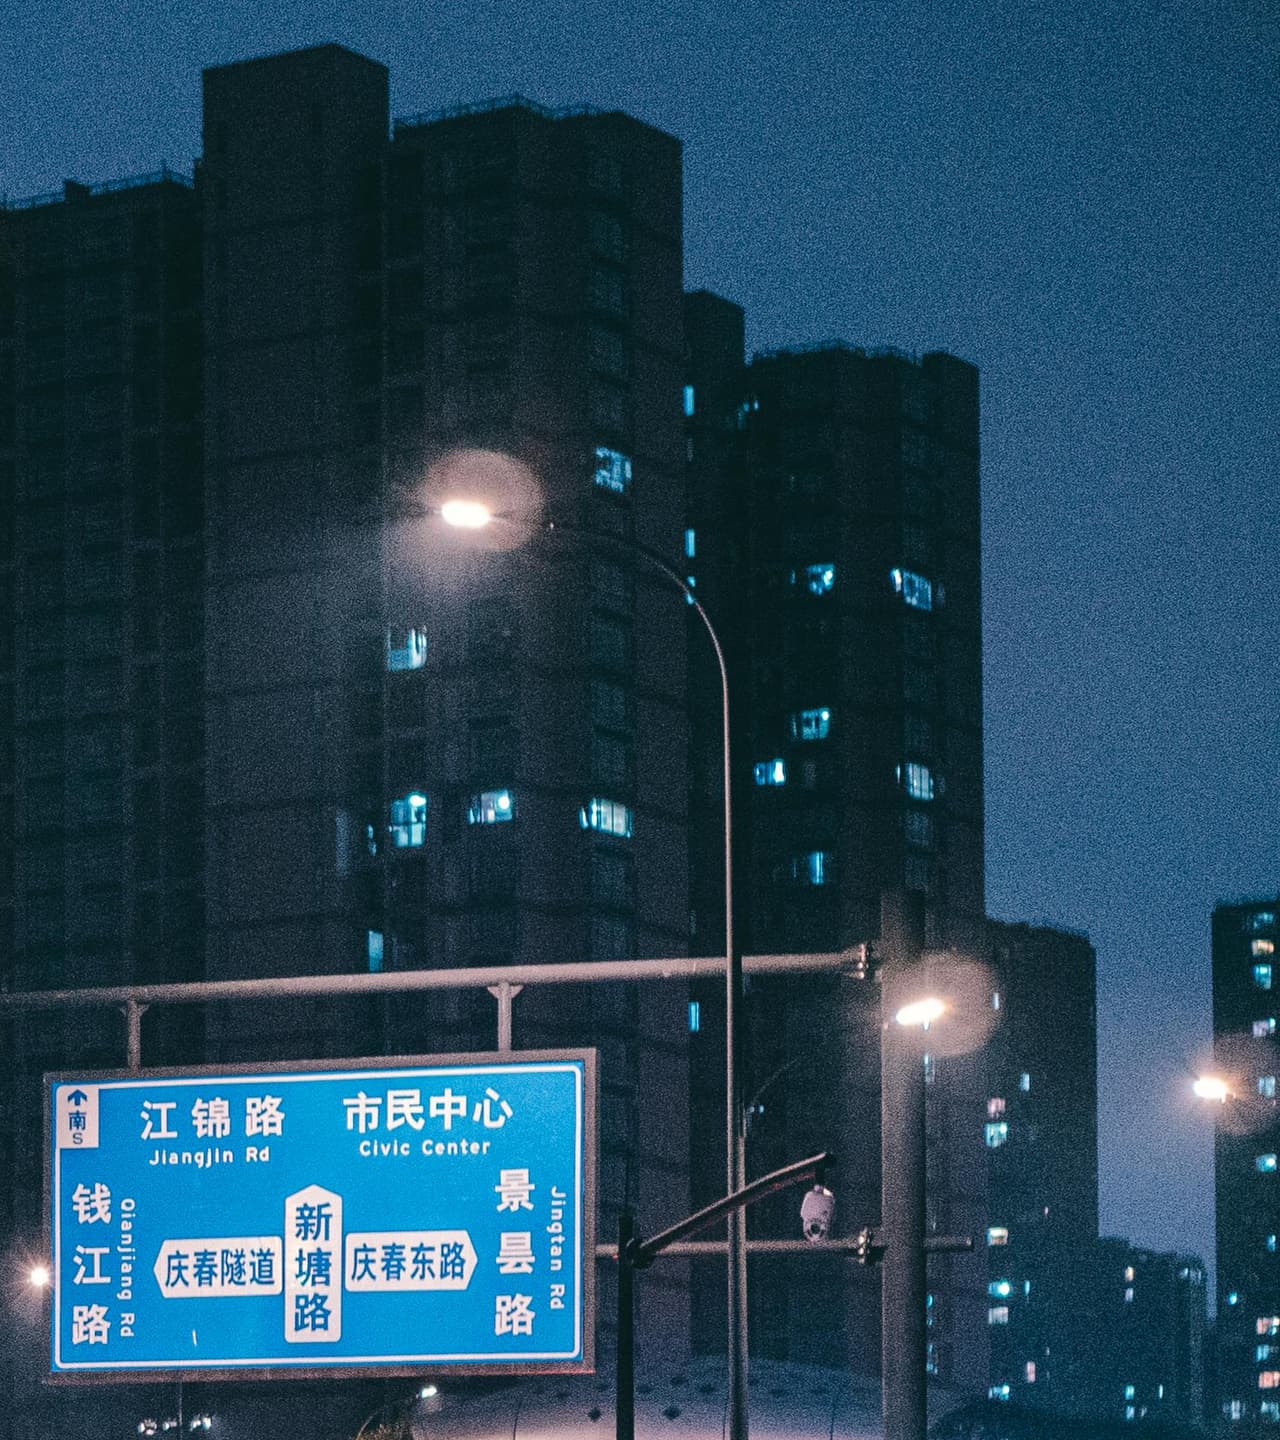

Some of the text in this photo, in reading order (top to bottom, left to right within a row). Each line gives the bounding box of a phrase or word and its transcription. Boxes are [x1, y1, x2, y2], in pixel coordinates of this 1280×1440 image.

[68, 1111, 87, 1131] 南
[140, 1095, 285, 1141] 江锦路
[343, 1087, 513, 1133] 市民中心
[72, 1132, 83, 1145] S
[149, 1146, 270, 1168] Jiangjin Rd
[359, 1138, 491, 1157] Civic Center
[72, 1183, 111, 1345] 钱江路
[117, 1198, 135, 1338] Qianjiang Rd
[165, 1248, 276, 1287] 庆春隧道
[294, 1202, 333, 1331] 新塘路
[351, 1242, 466, 1282] 庆春东路
[494, 1168, 536, 1336] 景昙路
[549, 1186, 566, 1310] Jingtan Rd
